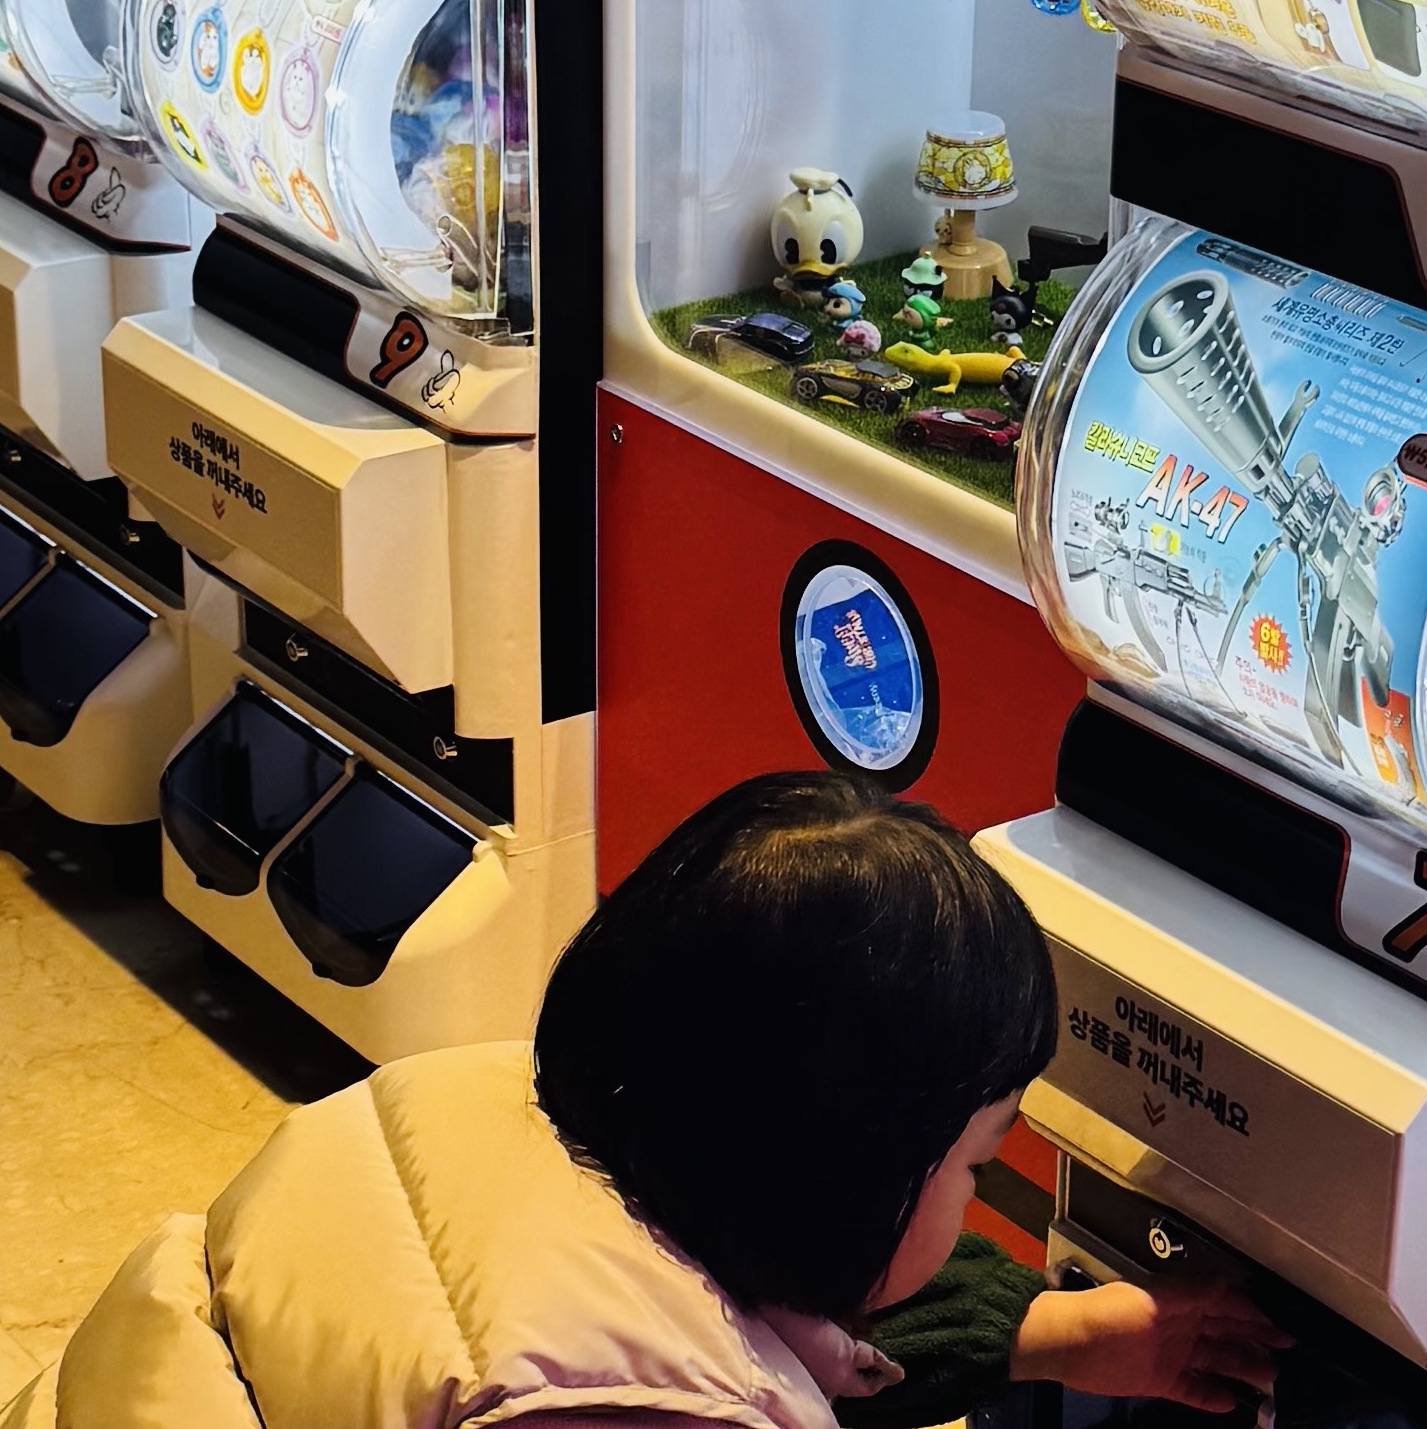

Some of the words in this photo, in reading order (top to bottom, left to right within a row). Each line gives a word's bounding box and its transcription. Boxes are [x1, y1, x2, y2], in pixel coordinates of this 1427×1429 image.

[48, 137, 97, 208] 8
[369, 311, 430, 388] 9
[169, 435, 205, 478] 상품을
[206, 458, 268, 514] 꺼내주세요
[191, 421, 240, 472] 아래에서
[1135, 453, 1250, 545] AK-47
[1113, 993, 1205, 1071] 아래에서
[1067, 1005, 1133, 1067] 상품을
[1135, 1048, 1251, 1138] 꺼내주세요
